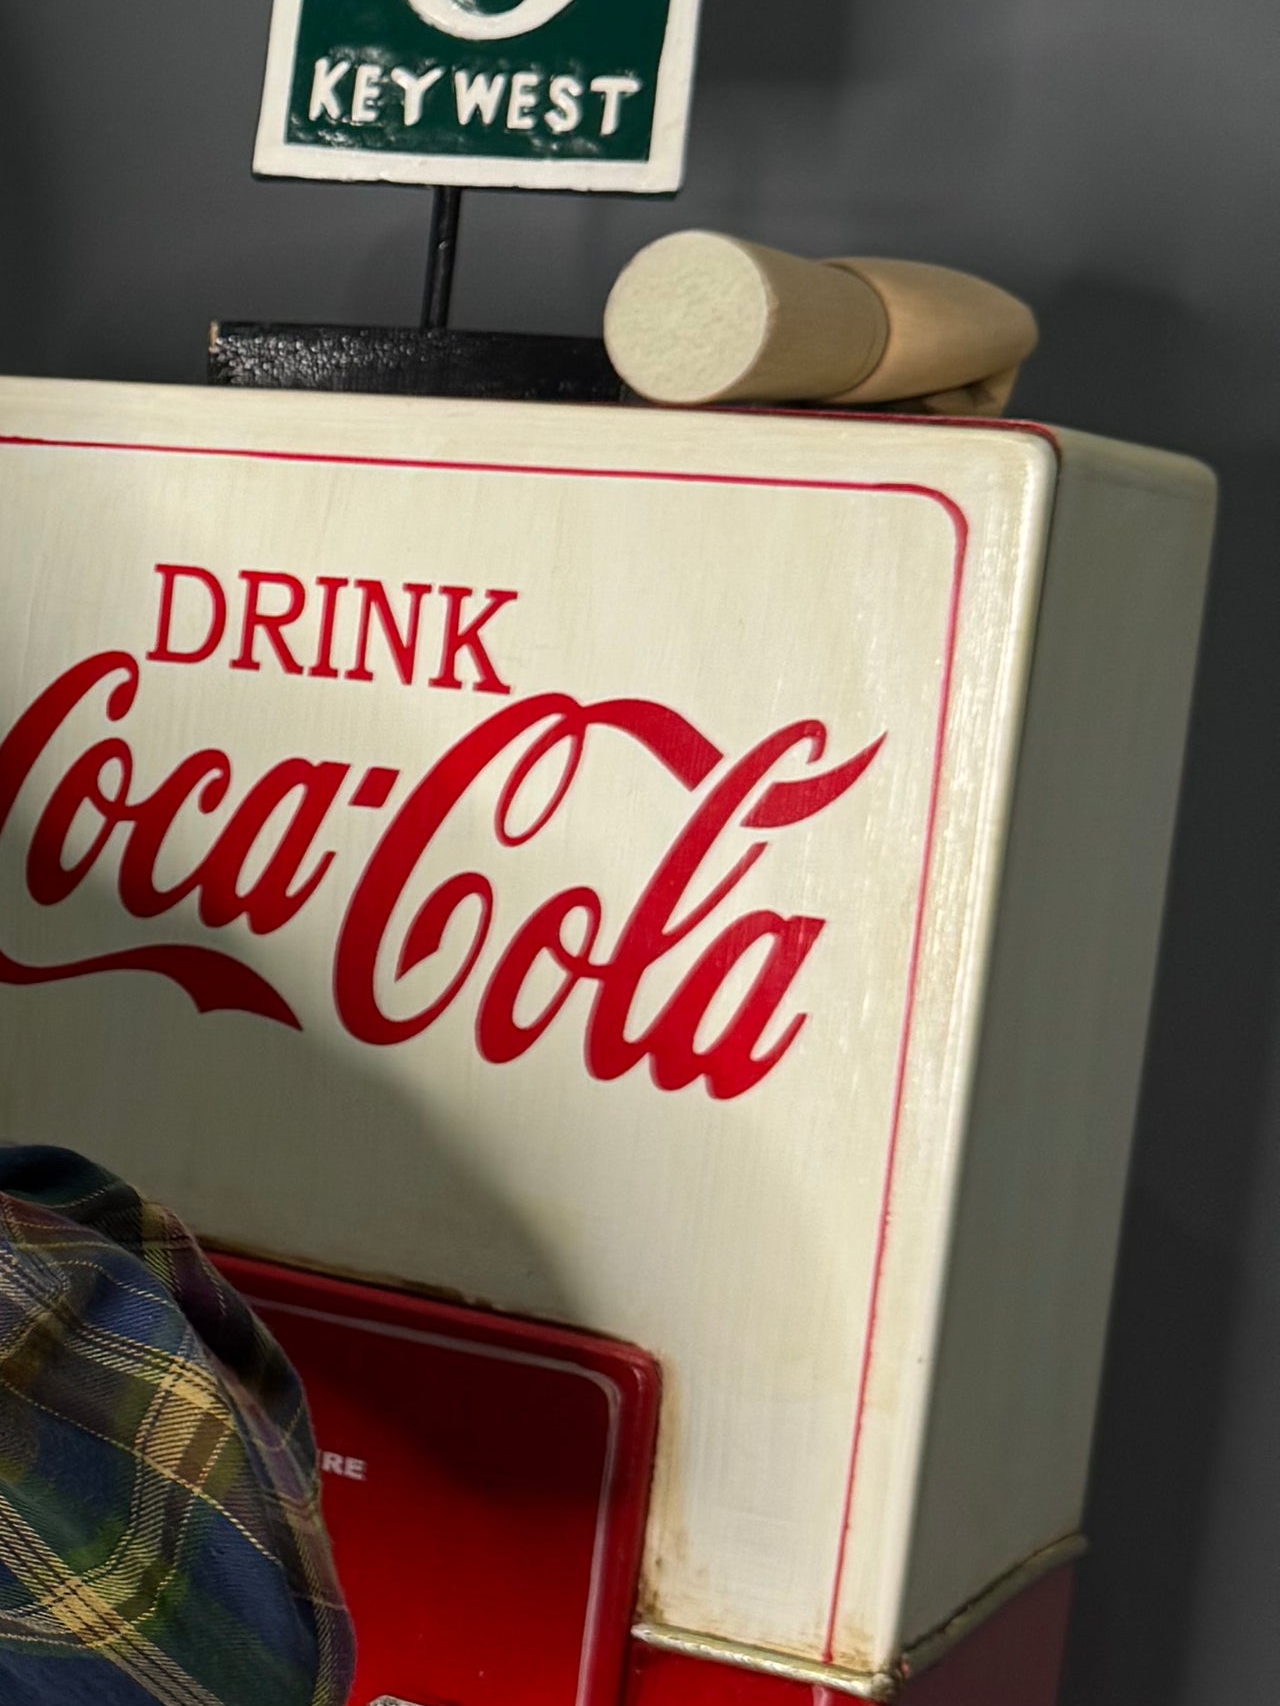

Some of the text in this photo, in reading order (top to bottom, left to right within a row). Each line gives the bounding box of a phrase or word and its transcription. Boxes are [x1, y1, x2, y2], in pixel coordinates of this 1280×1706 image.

[308, 56, 642, 136] KEY WEST
[146, 562, 519, 694] DRINK
[318, 1449, 368, 1482] RE
